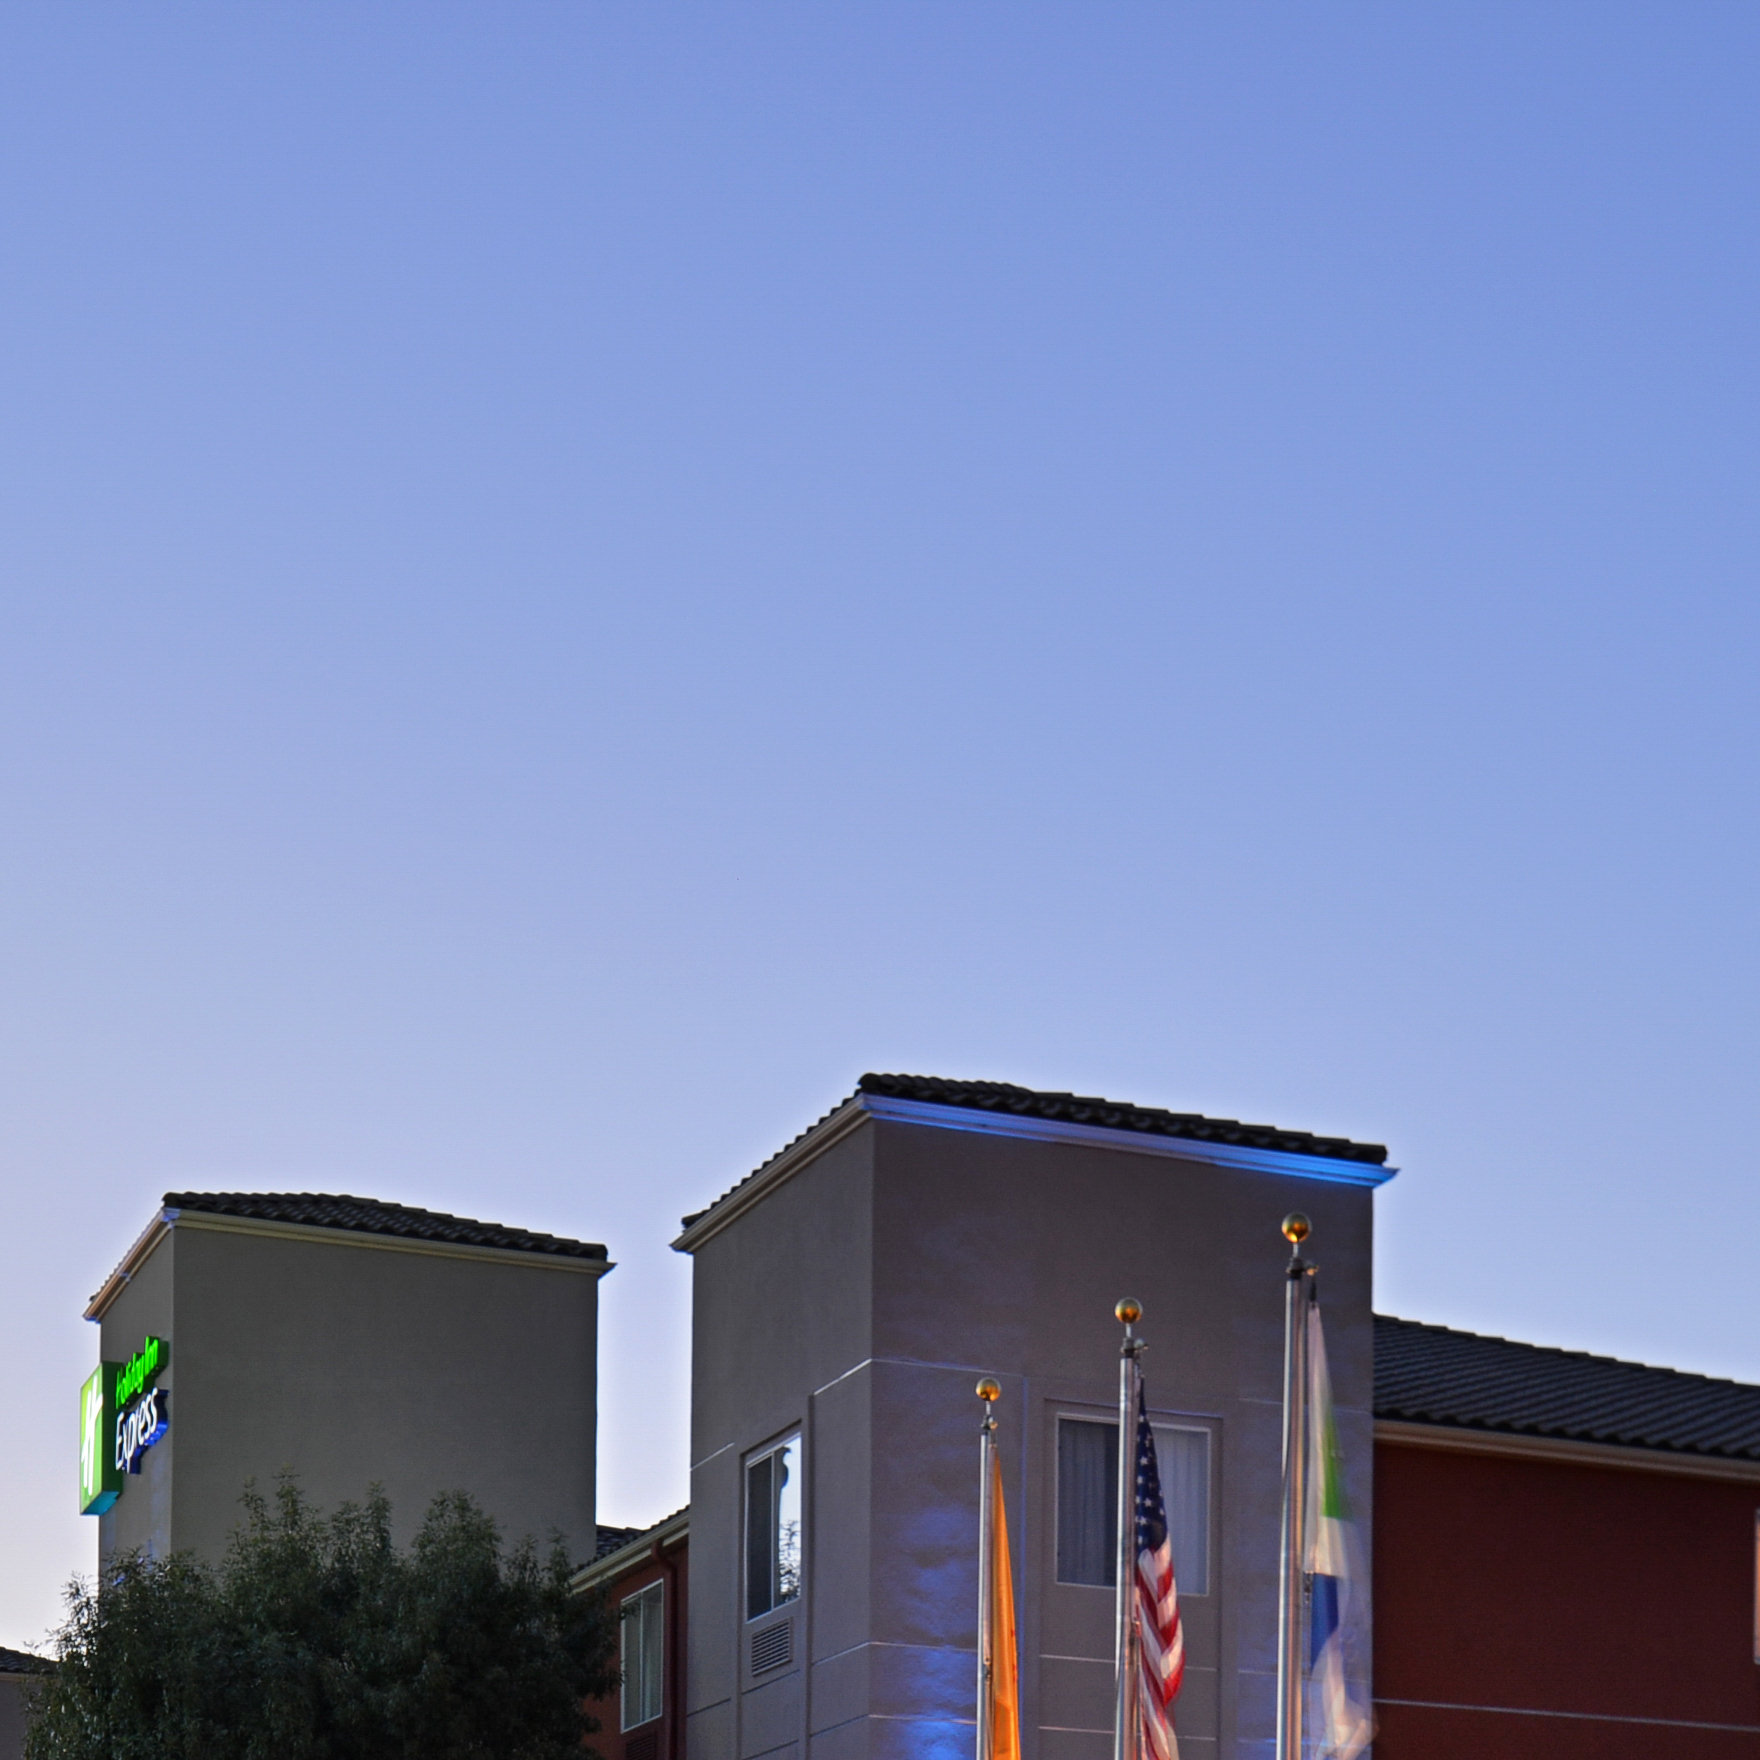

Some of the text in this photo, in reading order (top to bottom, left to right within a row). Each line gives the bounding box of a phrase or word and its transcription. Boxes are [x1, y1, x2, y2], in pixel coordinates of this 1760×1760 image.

[115, 1336, 159, 1409] Holiday Inn
[115, 1386, 159, 1474] Express
